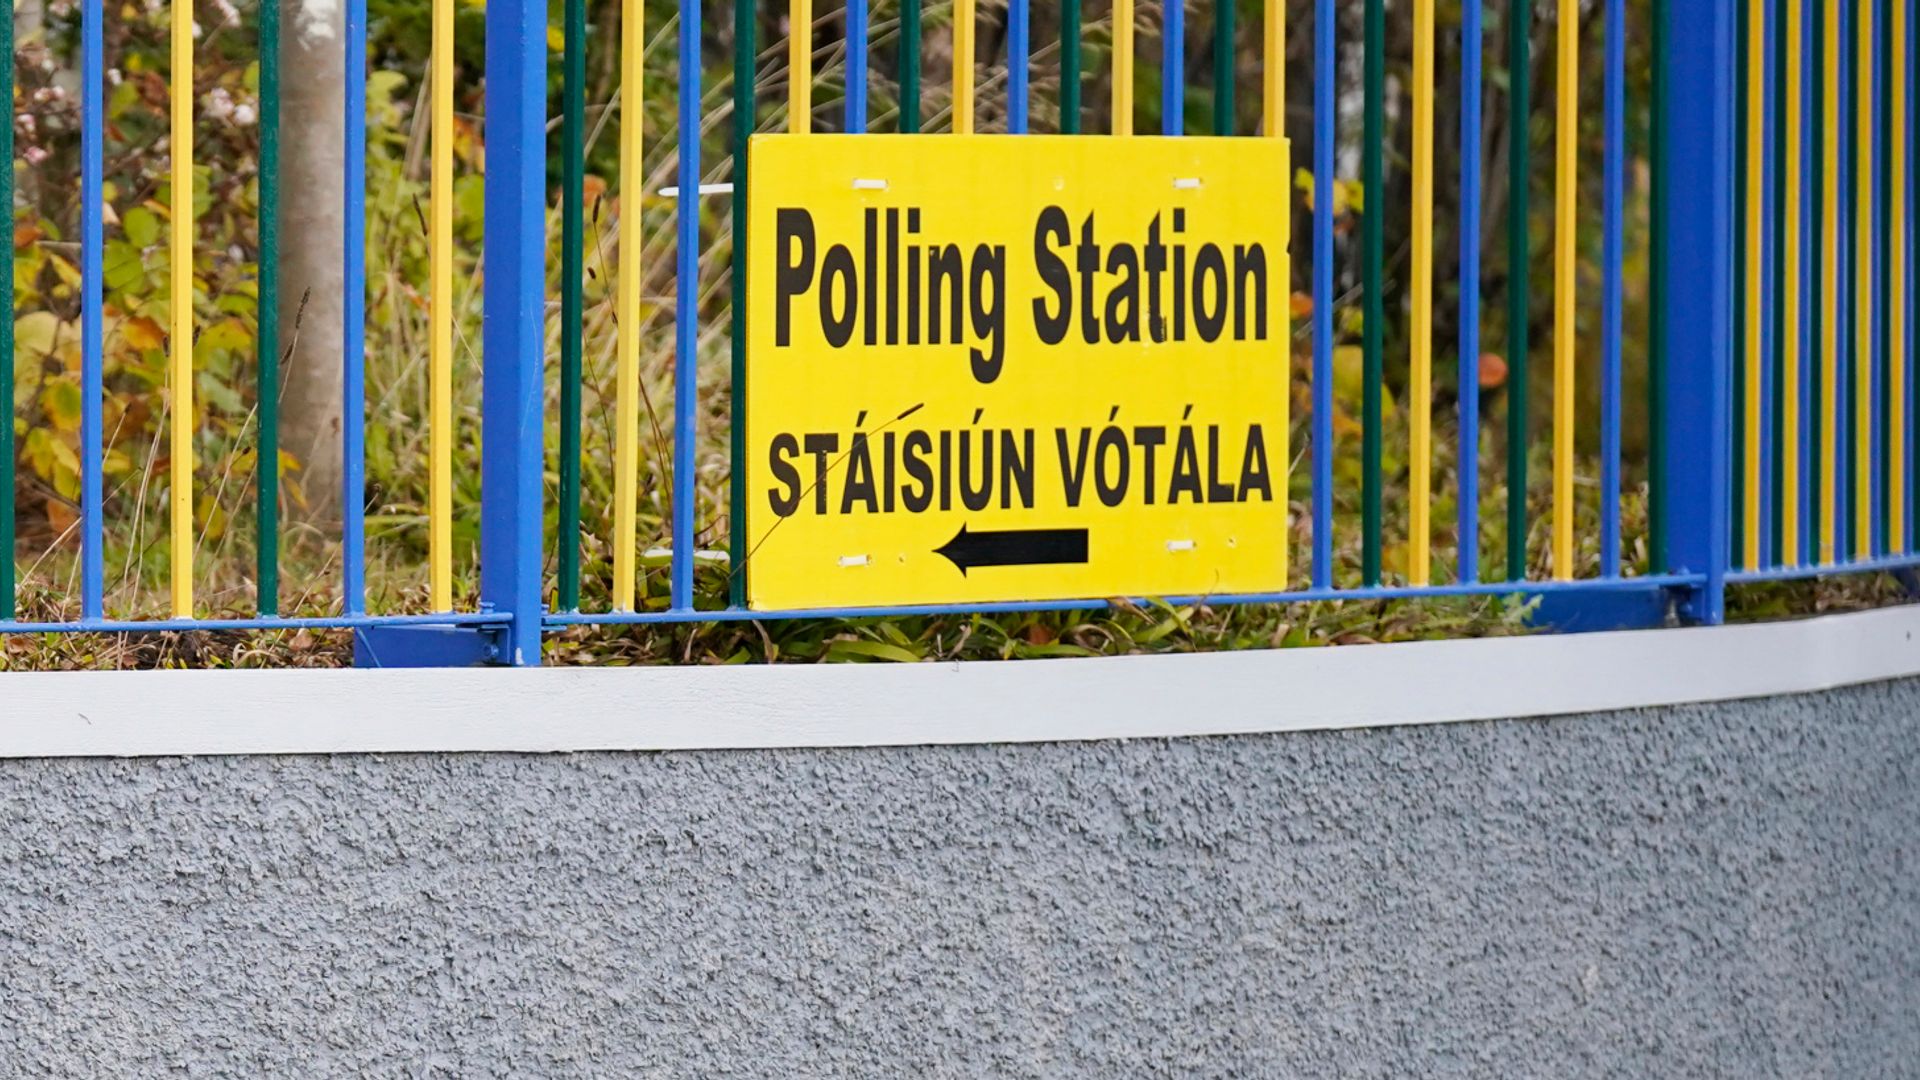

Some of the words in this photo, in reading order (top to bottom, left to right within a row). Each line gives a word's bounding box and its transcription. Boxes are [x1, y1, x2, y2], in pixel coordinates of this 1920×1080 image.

[775, 207, 1005, 384] Polling
[1032, 205, 1268, 345] Station
[768, 407, 1034, 518] STÁISIÚN
[1055, 404, 1273, 508] VÓTÁLA
